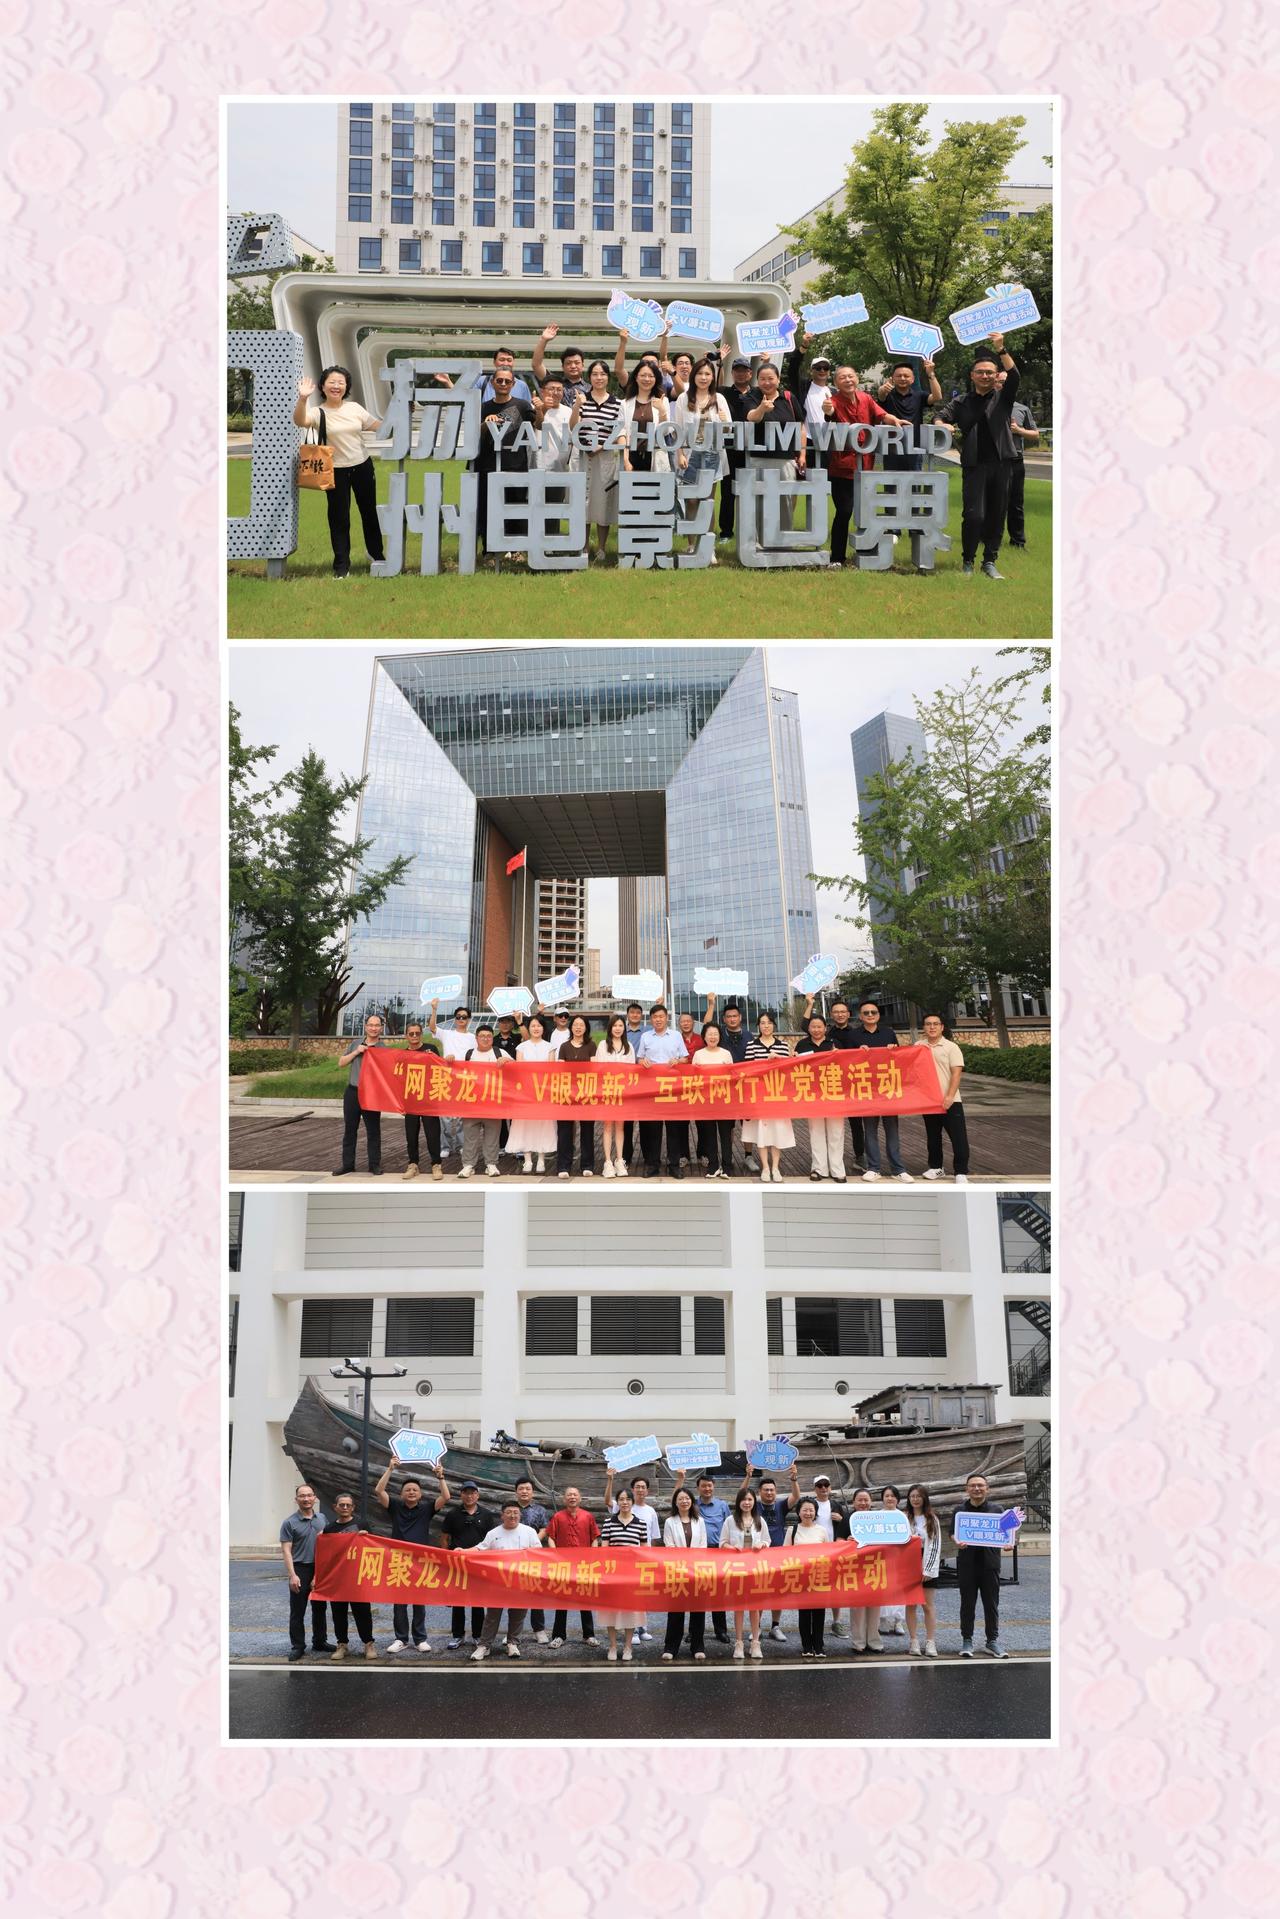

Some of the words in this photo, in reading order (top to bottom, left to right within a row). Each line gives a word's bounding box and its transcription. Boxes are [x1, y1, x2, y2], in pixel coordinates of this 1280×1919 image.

[625, 315, 654, 337] 观新
[742, 325, 779, 338] 网聚龙川
[898, 336, 929, 352] 龙川
[808, 422, 952, 456] WORLD
[654, 1060, 903, 1105] 互联网行业党建活动
[756, 1443, 777, 1453] V眼
[764, 1454, 790, 1465] 观新
[960, 1518, 1001, 1529] 网聚龙川
[634, 1550, 888, 1599] 互联网行业党建活动
